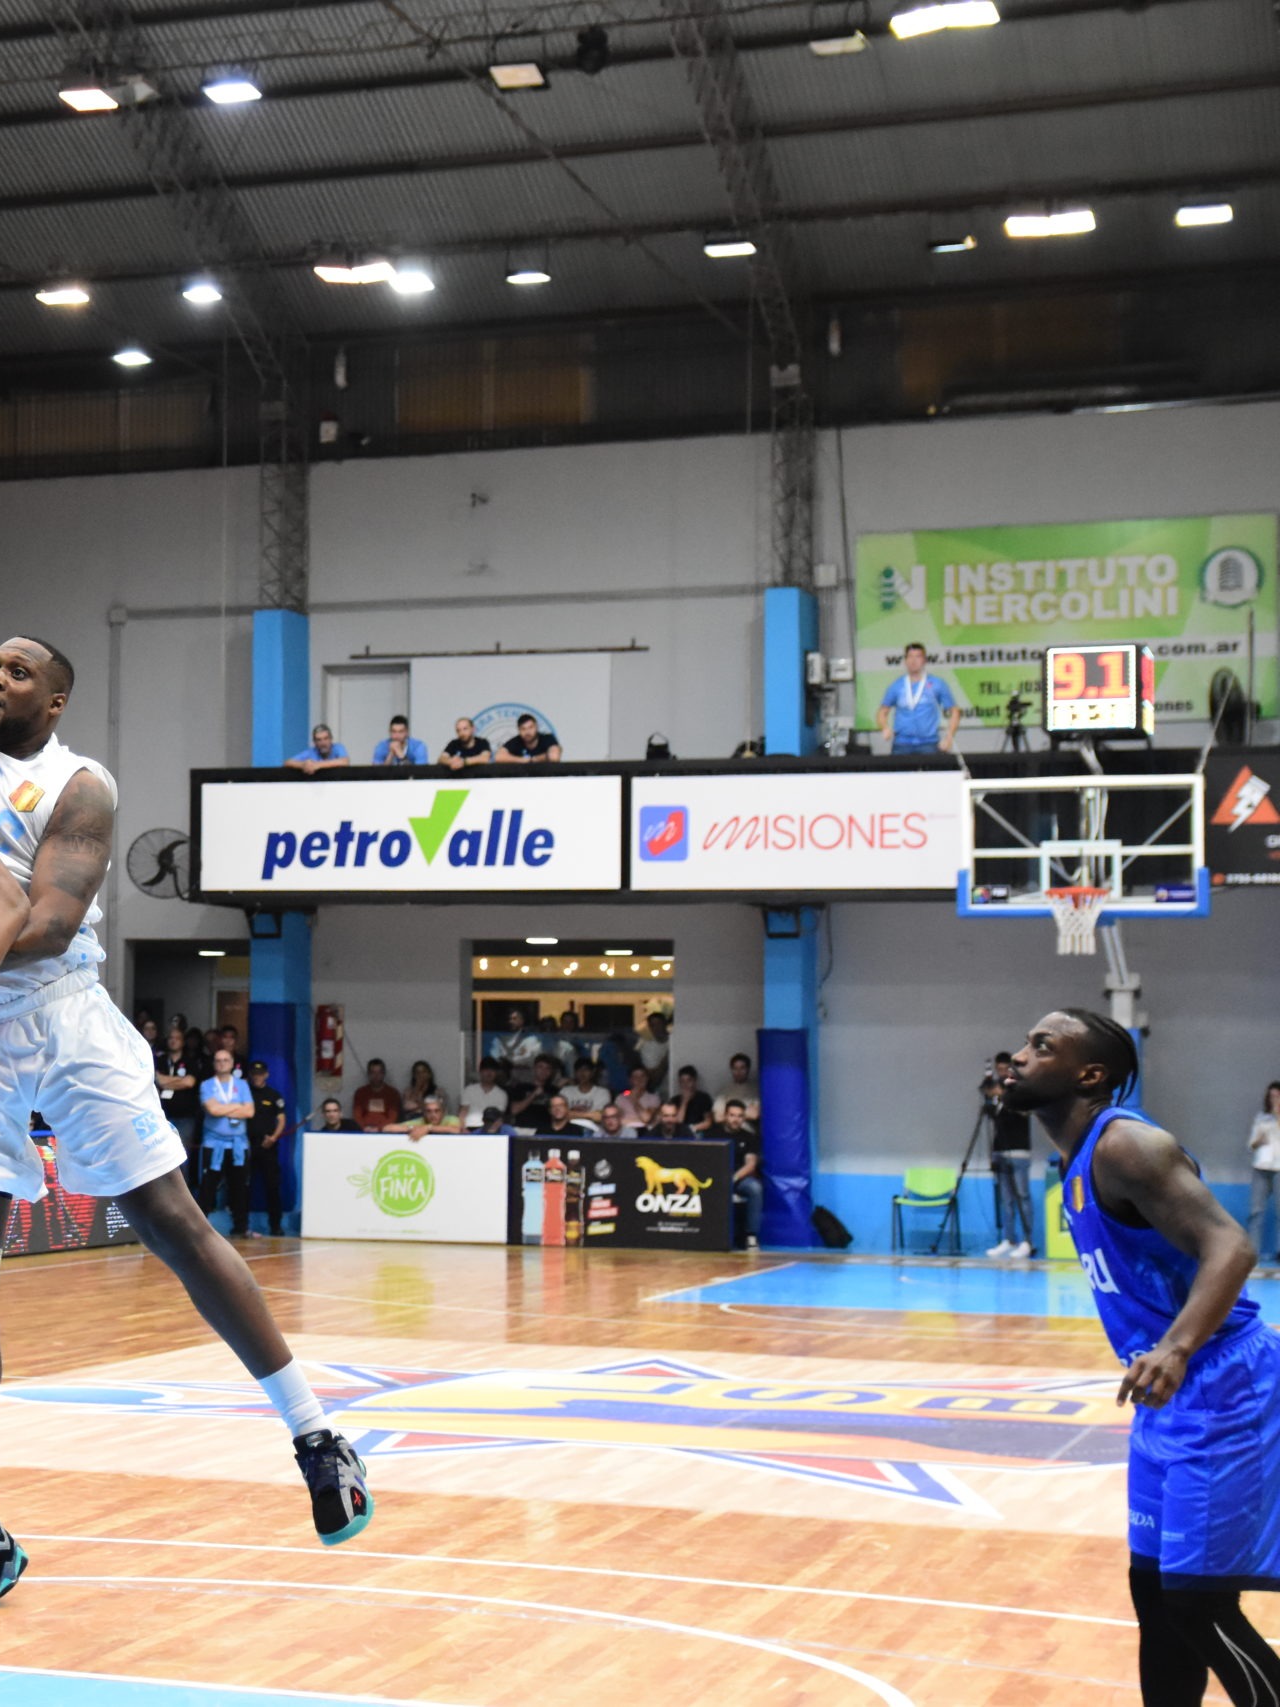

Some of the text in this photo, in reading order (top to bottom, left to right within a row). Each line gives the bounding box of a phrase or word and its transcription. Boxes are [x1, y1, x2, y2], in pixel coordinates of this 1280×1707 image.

[943, 554, 1178, 595] INSTITUTO
[943, 586, 1179, 626] NERCOLINI
[1052, 651, 1131, 701] 9.1
[380, 1176, 428, 1202] FINCA
[635, 1193, 702, 1214] ONZA
